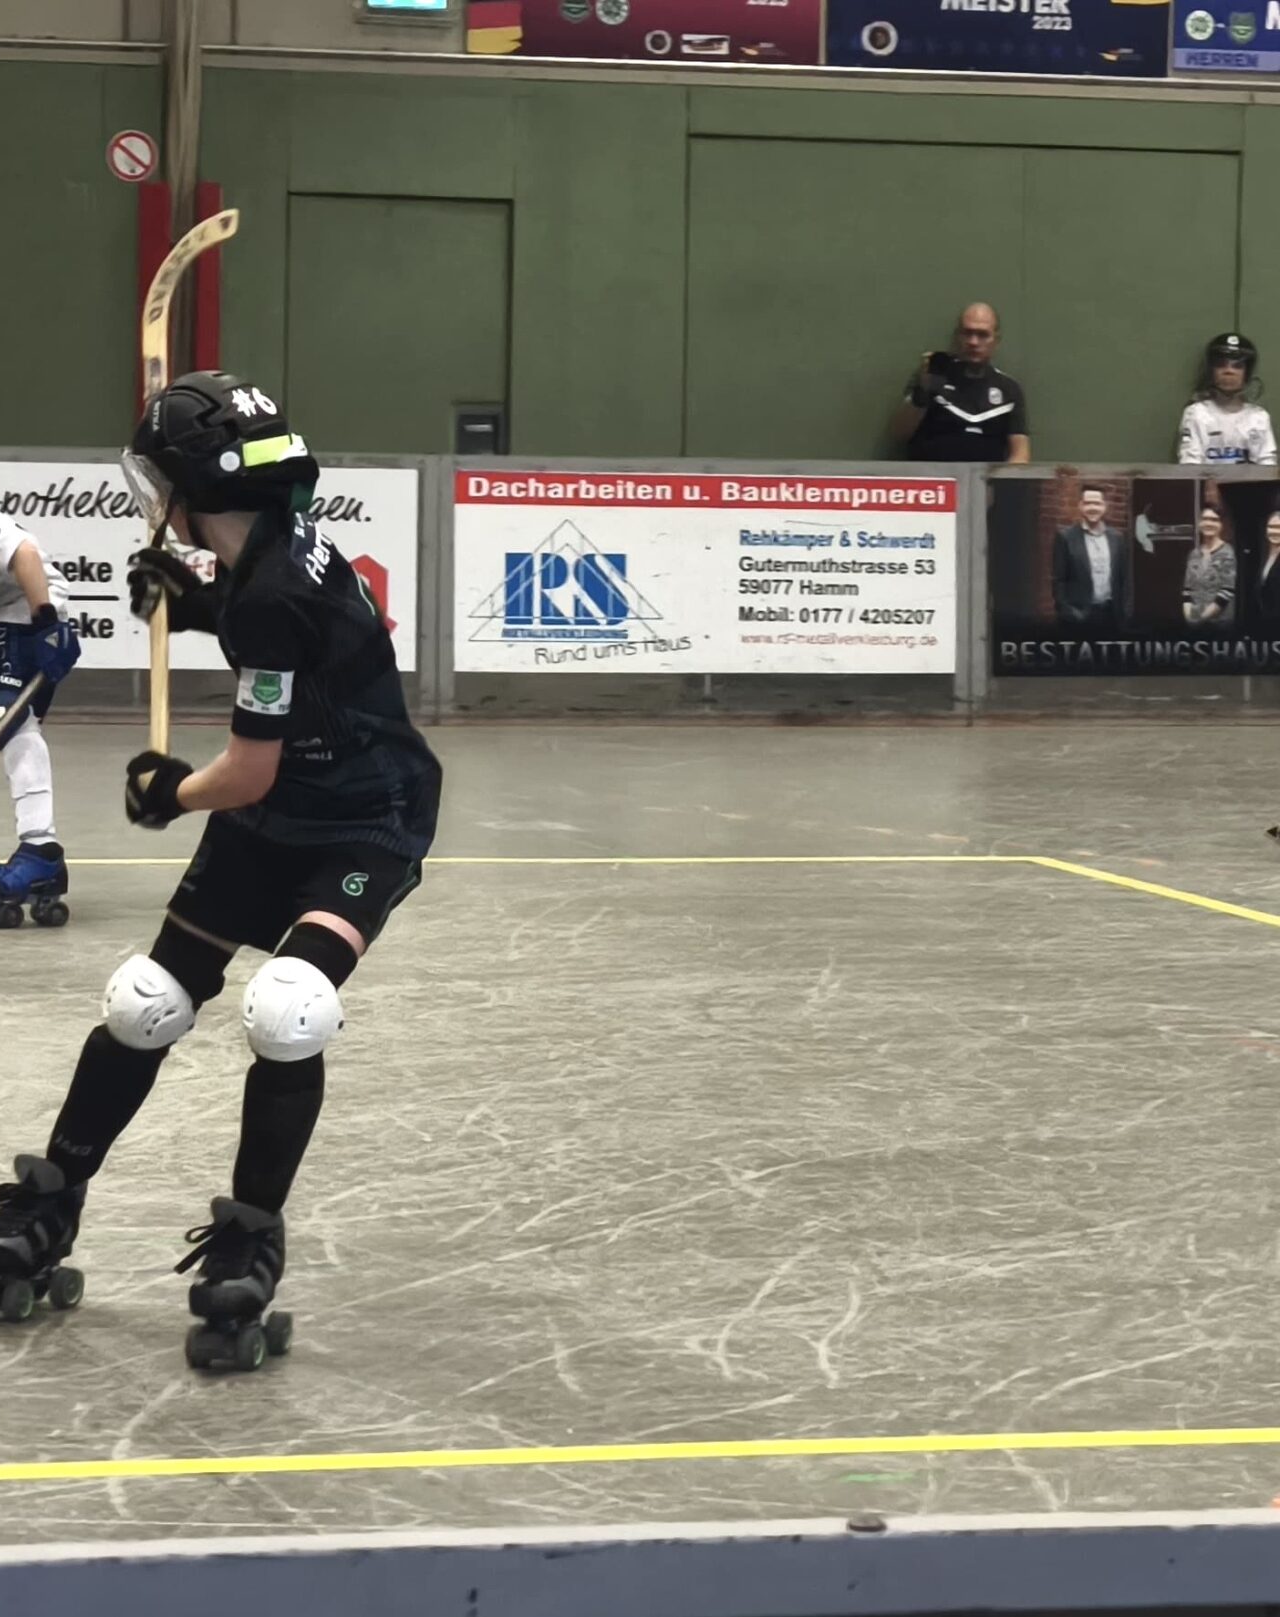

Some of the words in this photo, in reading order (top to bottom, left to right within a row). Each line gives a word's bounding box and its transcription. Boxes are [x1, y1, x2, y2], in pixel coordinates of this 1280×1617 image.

[1032, 15, 1072, 31] 2023
[231, 387, 278, 418] #6
[468, 476, 672, 500] Dacharbeiten
[684, 483, 710, 500] u.
[721, 481, 946, 507] Bauklempnerei
[740, 530, 834, 551] Rehkämper
[839, 531, 852, 548] &
[738, 556, 909, 575] Gutermuthstrasse
[914, 559, 936, 575] 53
[738, 578, 794, 595] 59077
[799, 580, 860, 596] Hamm
[738, 606, 794, 623] Mobil:
[798, 608, 843, 624] 0177
[847, 608, 856, 623] /
[859, 609, 936, 625] 4205207
[534, 645, 587, 665] Rund
[594, 642, 637, 659] ums
[342, 872, 369, 896] 6
